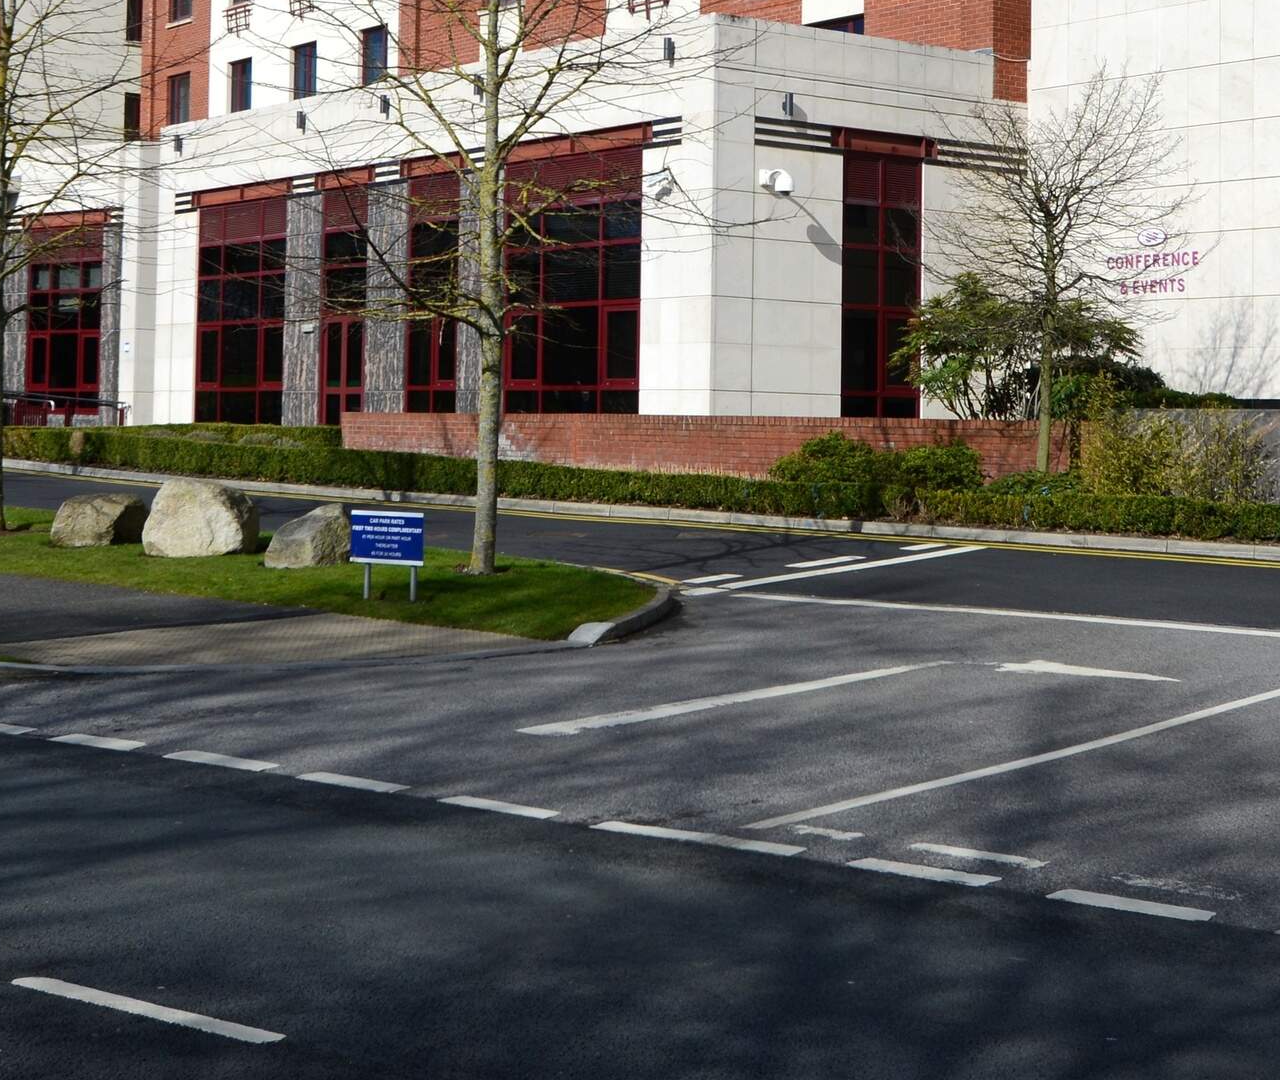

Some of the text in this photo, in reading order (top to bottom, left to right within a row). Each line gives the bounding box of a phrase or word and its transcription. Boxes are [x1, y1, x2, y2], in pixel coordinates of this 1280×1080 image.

[1107, 251, 1199, 270] CONFERENCE
[1120, 278, 1185, 295] & EVENTS
